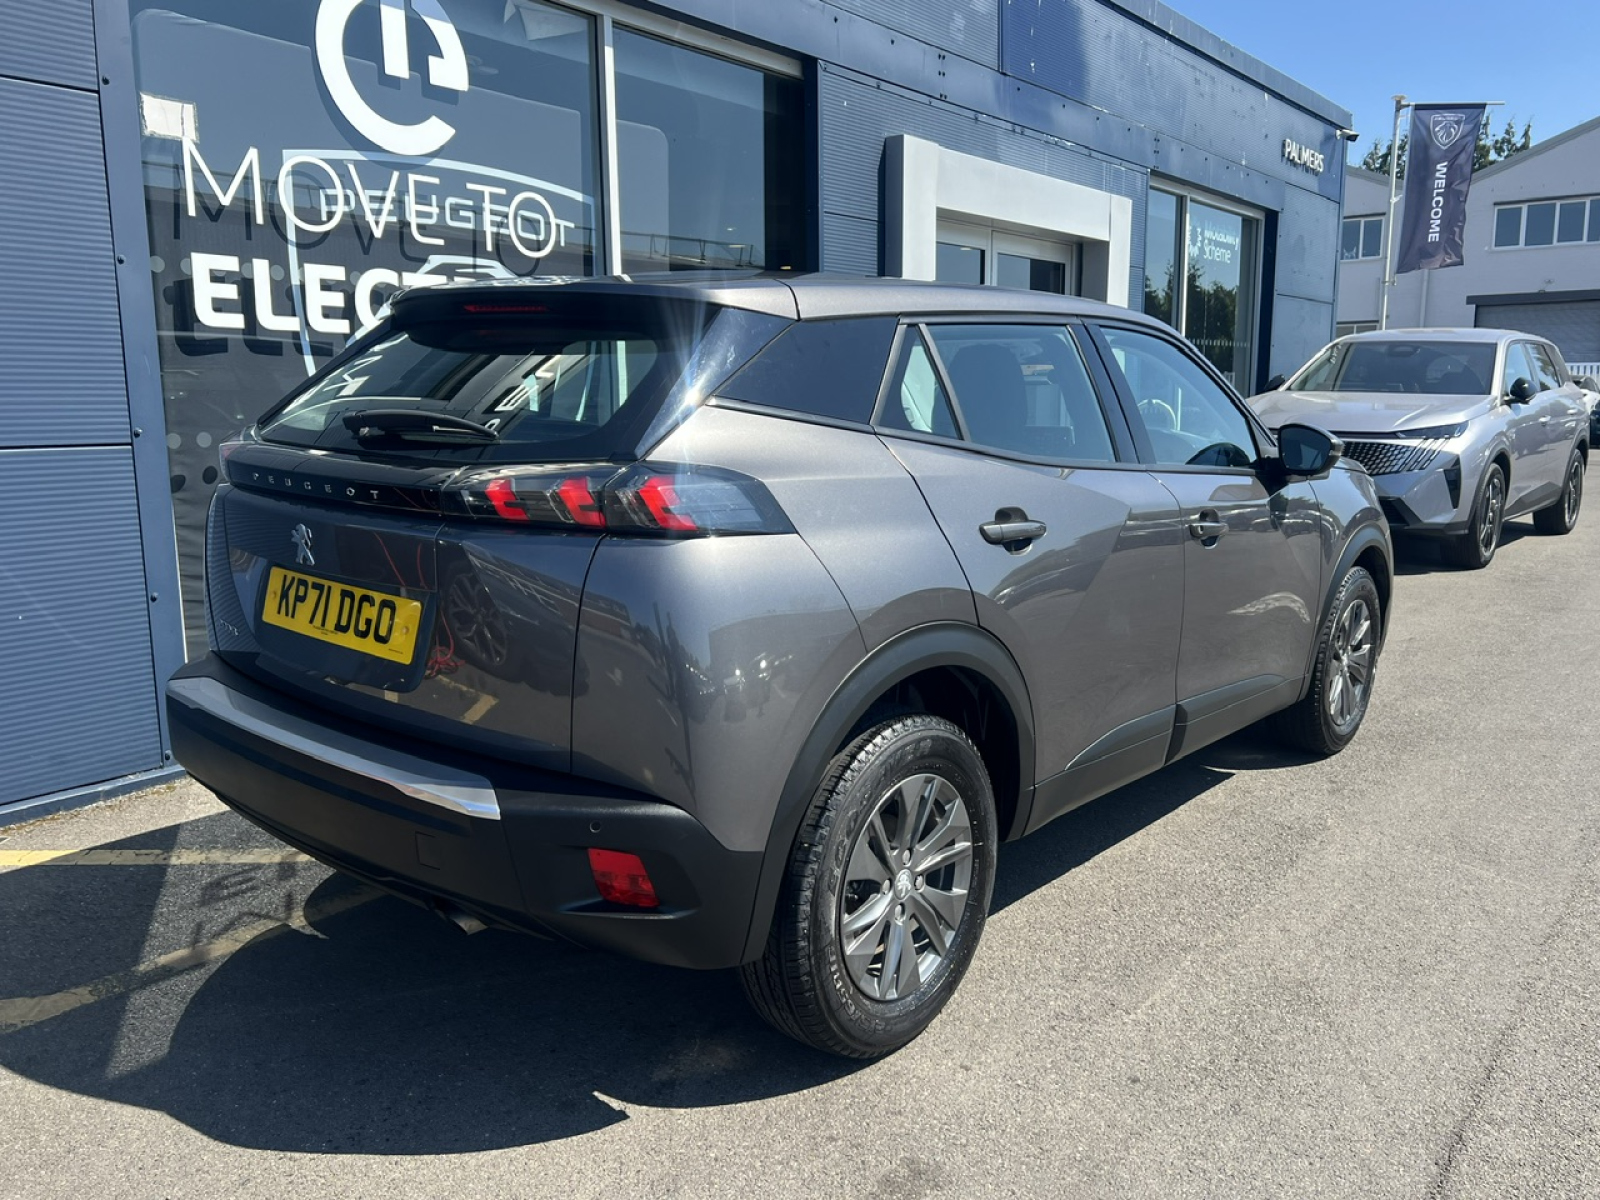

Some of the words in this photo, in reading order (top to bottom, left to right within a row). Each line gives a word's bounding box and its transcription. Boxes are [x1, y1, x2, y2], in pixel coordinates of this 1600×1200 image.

[1284, 138, 1324, 172] PALMERS
[183, 137, 445, 246] MOVE
[466, 183, 556, 258] TO
[319, 188, 575, 247] PEUGEOT
[1428, 161, 1448, 243] WELCOME
[253, 472, 379, 499] PEUGEOT
[277, 574, 331, 629] KP71
[335, 587, 396, 645] DGO
